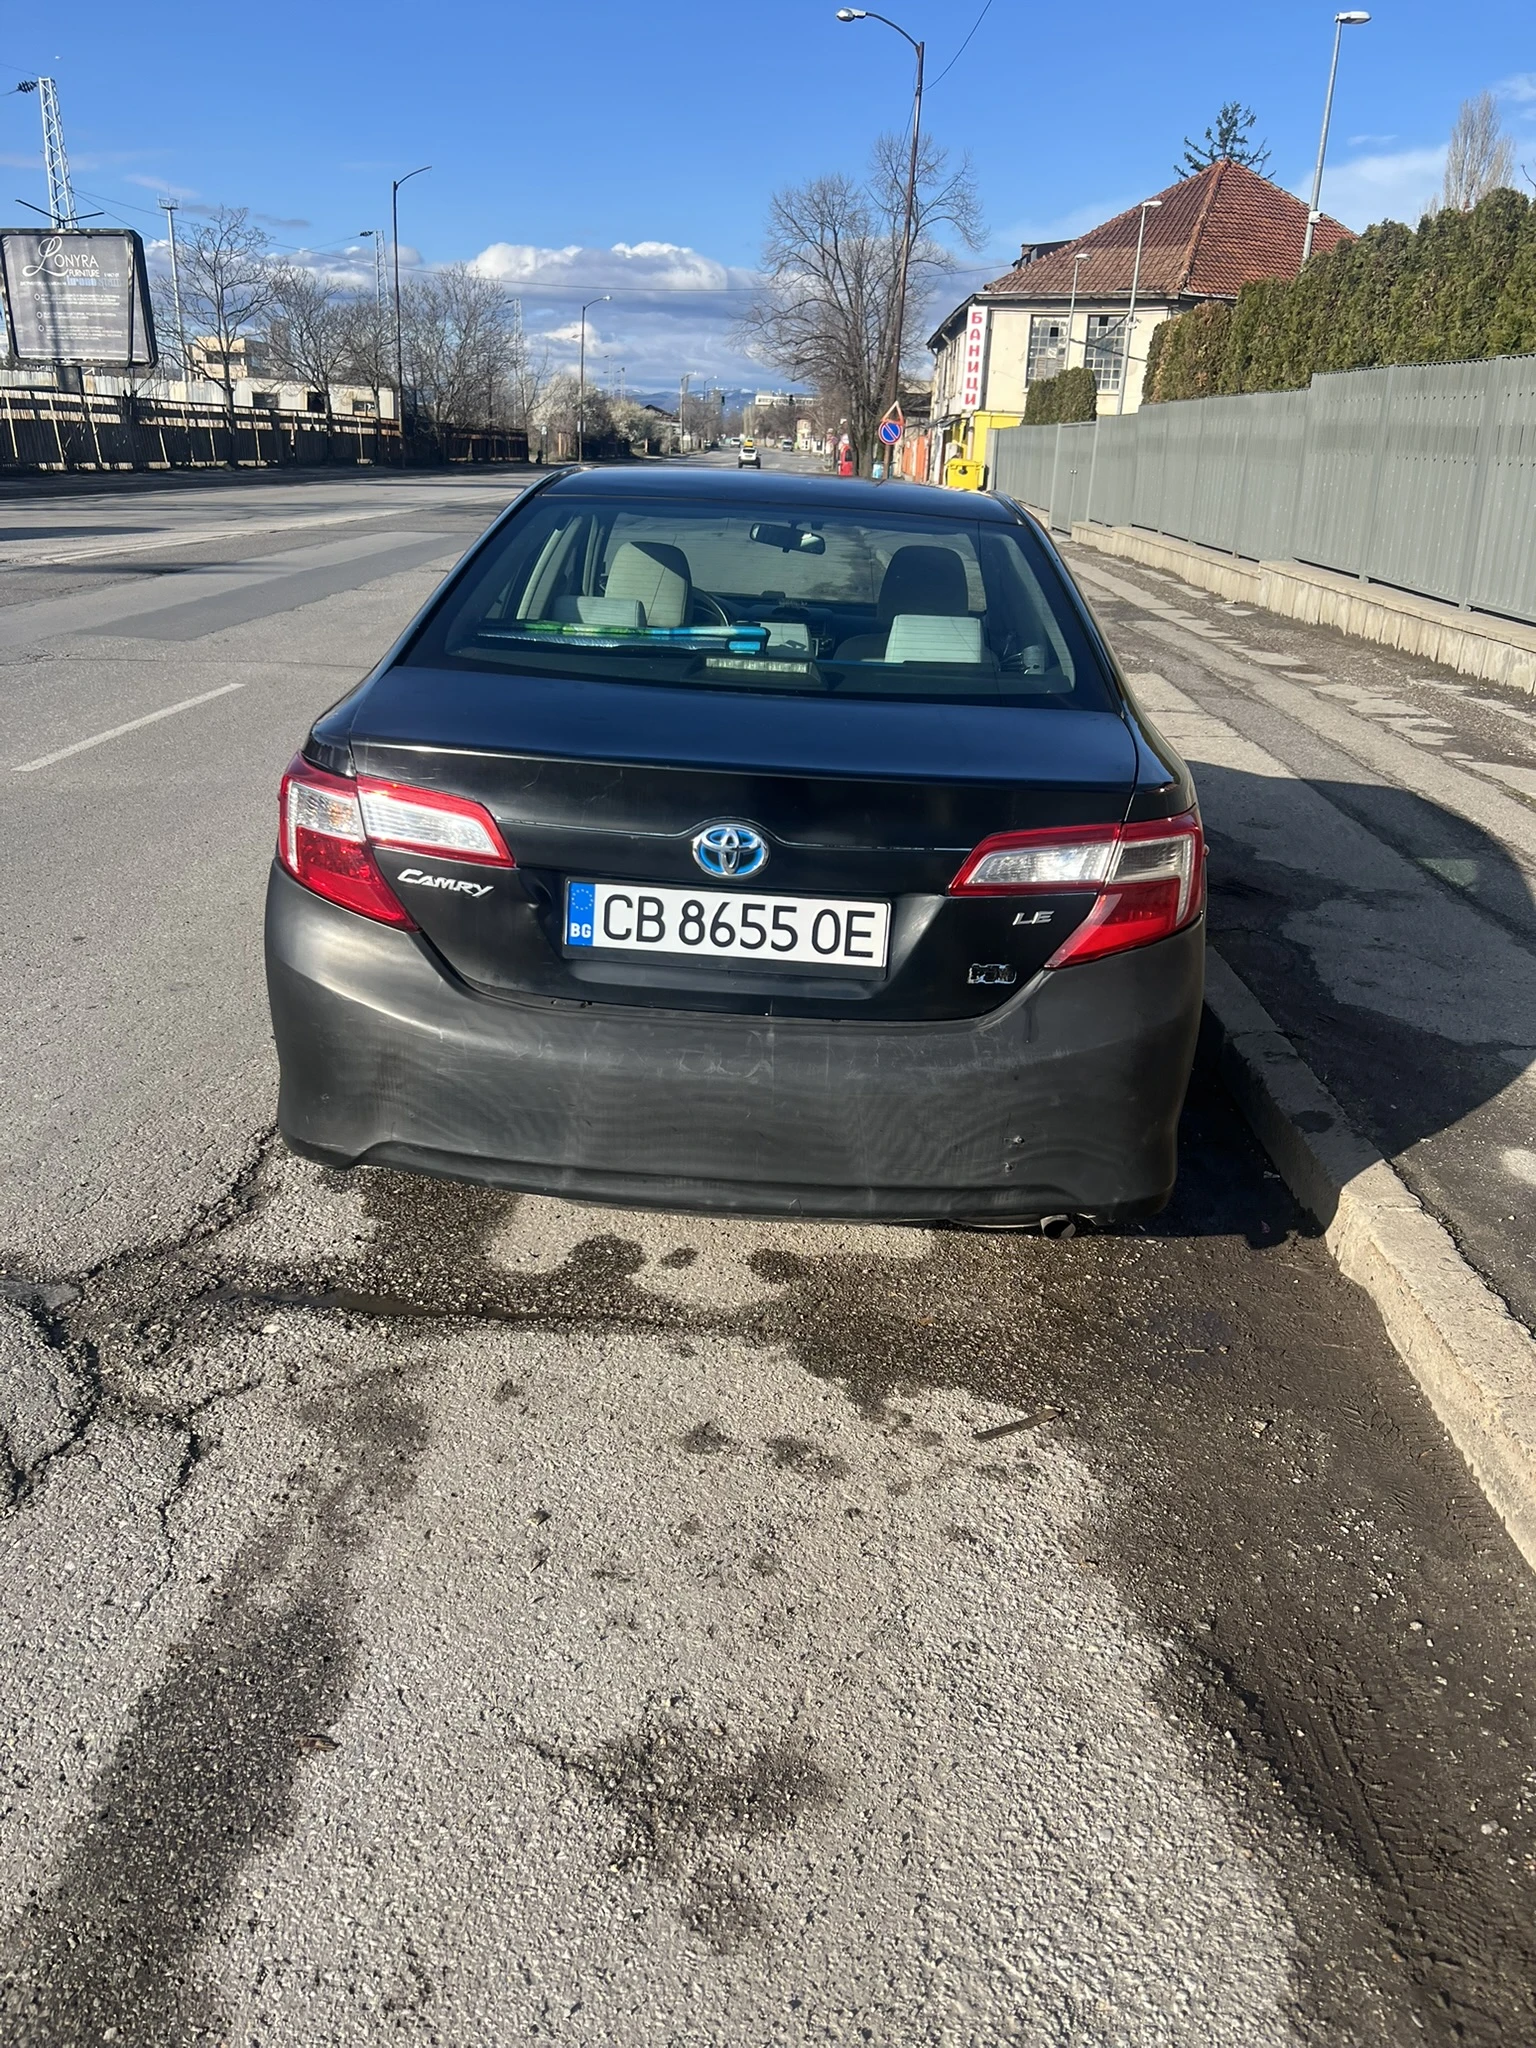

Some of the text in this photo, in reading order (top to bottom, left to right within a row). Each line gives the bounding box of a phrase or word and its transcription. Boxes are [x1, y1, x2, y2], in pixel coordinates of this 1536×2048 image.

[22, 236, 100, 277] LONYRA
[965, 311, 983, 405] БАНИЦИ
[397, 868, 495, 897] CAMRY
[570, 923, 592, 939] BG
[603, 894, 666, 943] CB
[678, 899, 798, 952] 8655
[1012, 910, 1055, 926] LE
